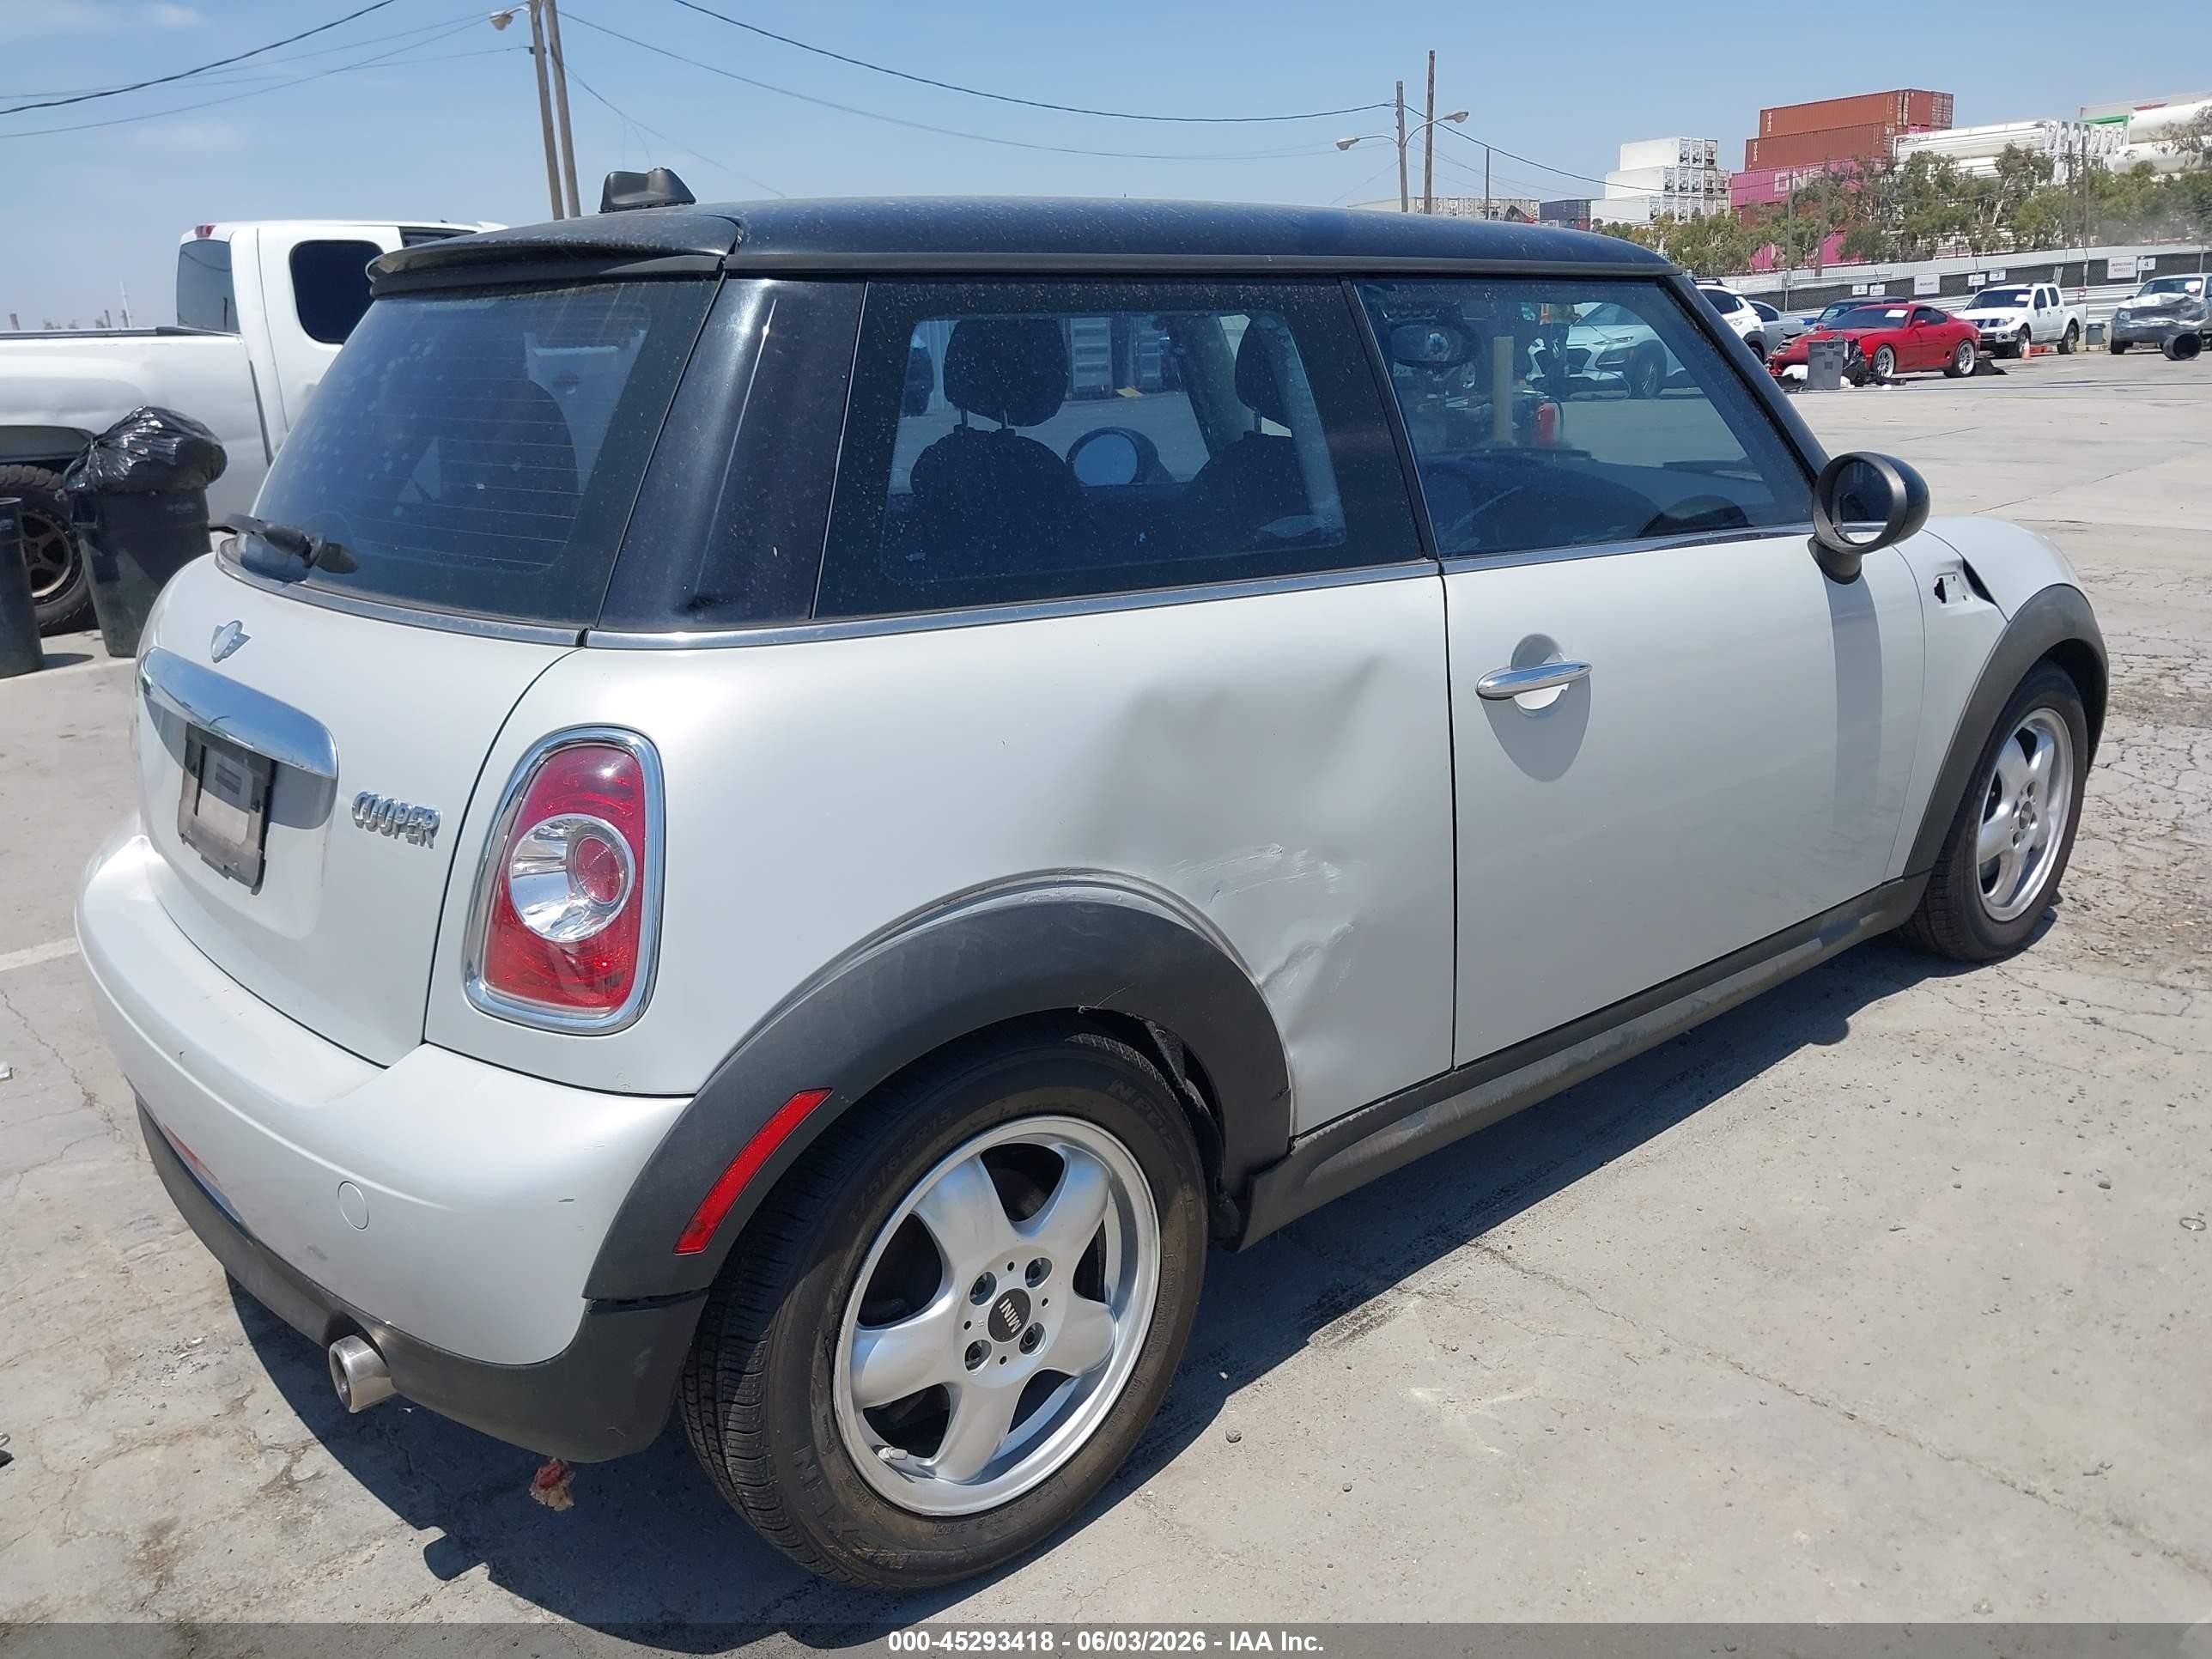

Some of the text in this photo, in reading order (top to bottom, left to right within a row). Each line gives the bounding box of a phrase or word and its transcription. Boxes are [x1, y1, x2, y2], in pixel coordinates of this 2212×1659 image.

[2143, 260, 2150, 269] 4
[351, 791, 442, 849] COOPER
[999, 1297, 1022, 1334] MINI
